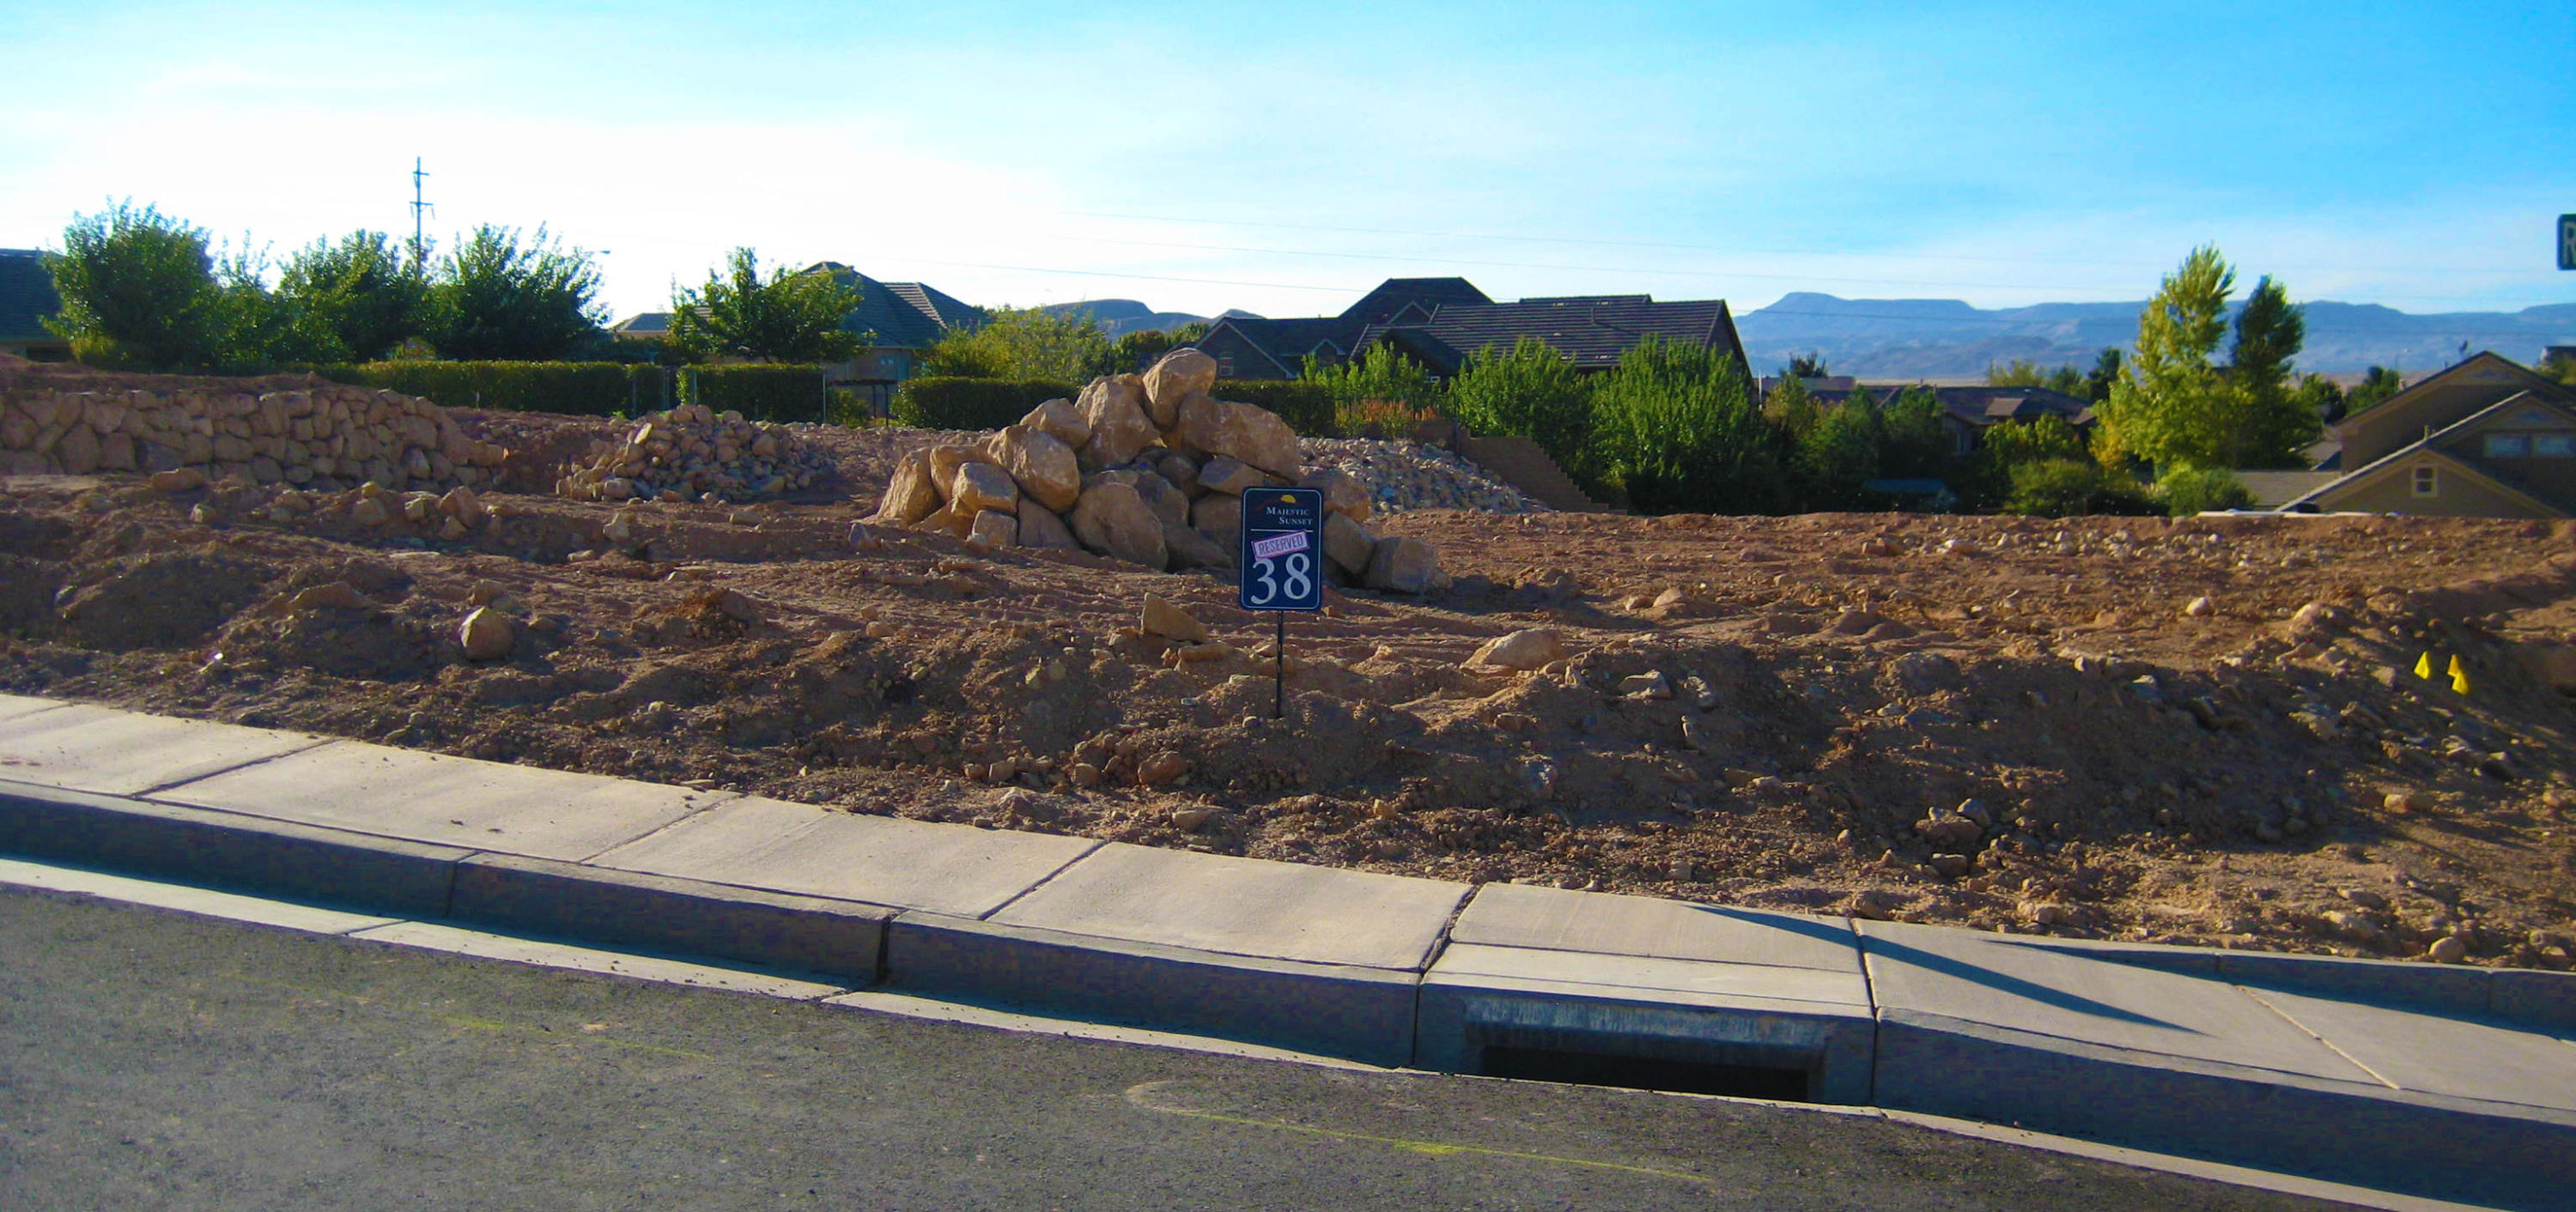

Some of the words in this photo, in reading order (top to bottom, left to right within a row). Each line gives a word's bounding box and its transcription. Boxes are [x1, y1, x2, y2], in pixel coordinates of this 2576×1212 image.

[1279, 517, 1313, 525] SUNSET
[1257, 534, 1304, 555] RESERVED
[1250, 553, 1311, 604] 38
